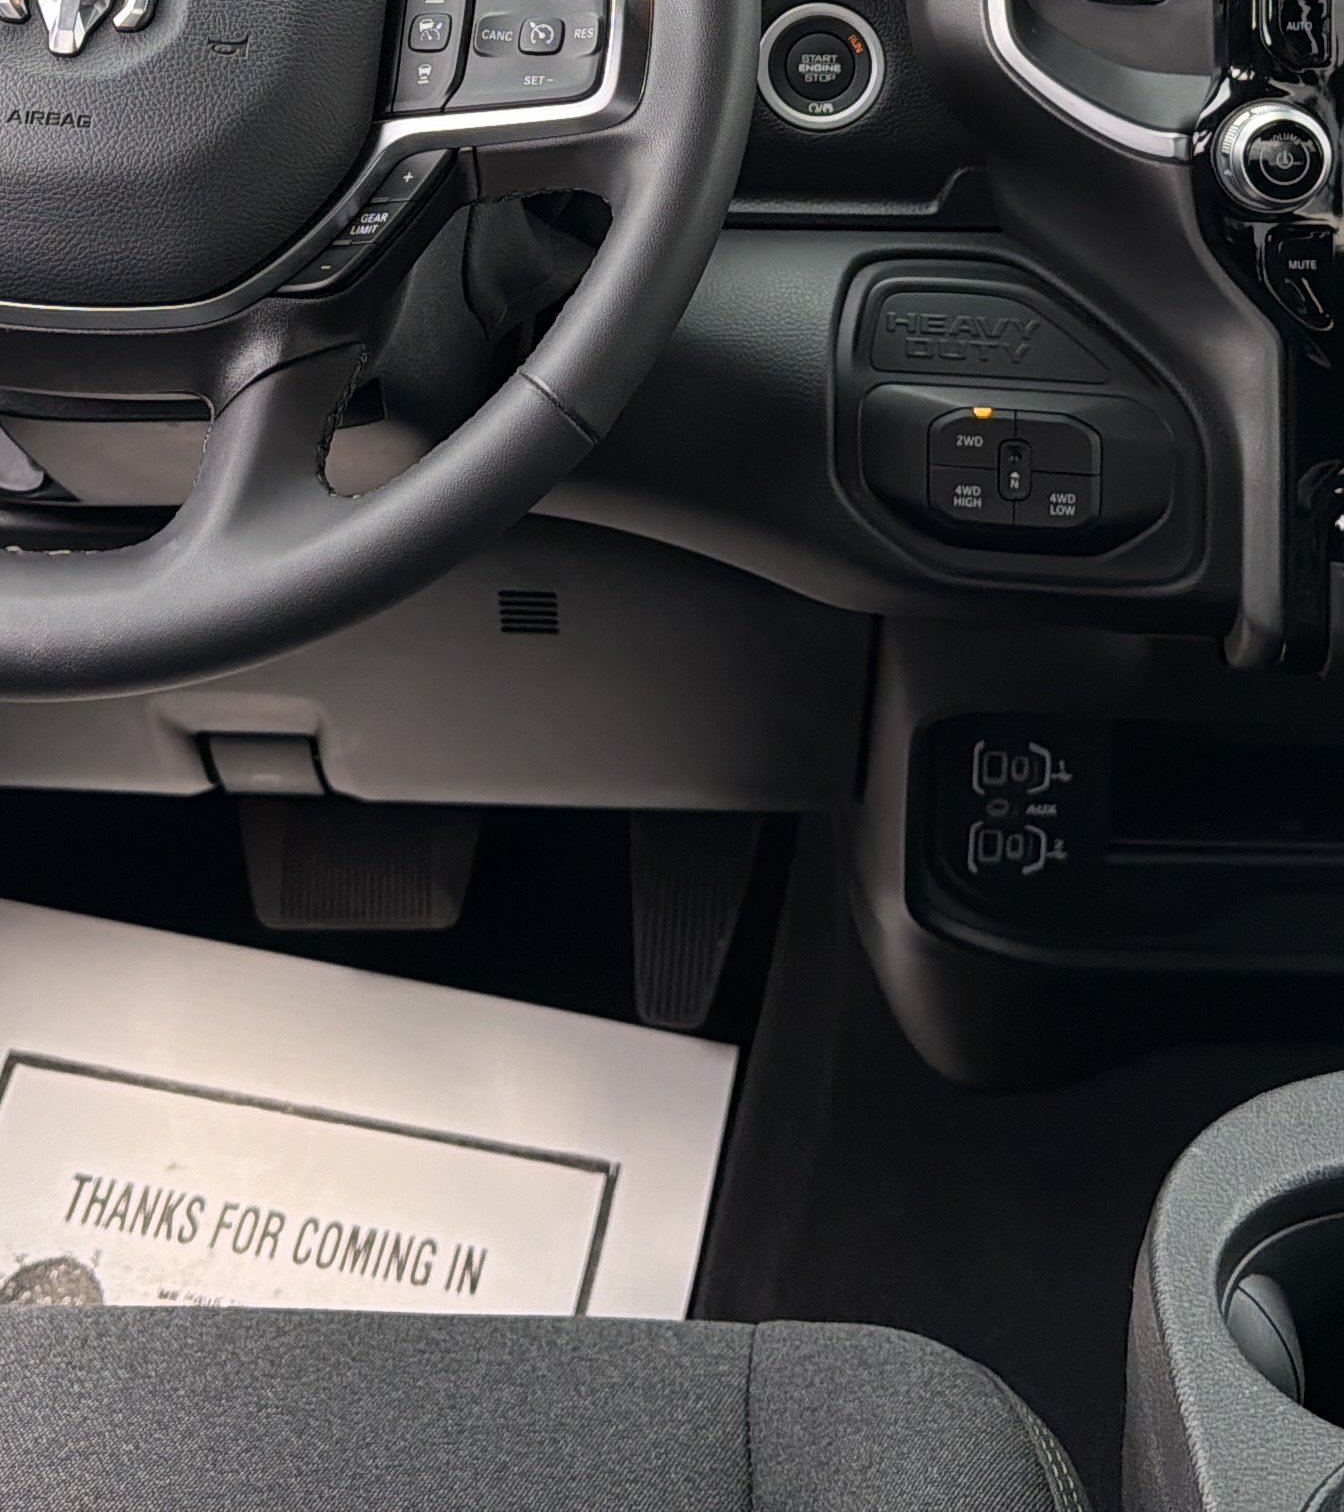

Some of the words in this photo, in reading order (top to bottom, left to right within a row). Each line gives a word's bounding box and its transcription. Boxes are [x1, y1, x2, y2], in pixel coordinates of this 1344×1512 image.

[1286, 20, 1313, 31] AUTO
[481, 28, 513, 41] CANC
[573, 28, 594, 39] RES
[801, 54, 838, 64] START
[798, 64, 842, 73] ENGINE
[804, 73, 836, 83] STOP
[5, 109, 92, 128] AIRBAG
[360, 212, 389, 224] GEAR
[349, 224, 379, 236] LIMIT
[1288, 259, 1318, 270] MUTE
[886, 311, 1041, 339] HEAVY
[906, 337, 1032, 364] DUTY
[956, 434, 984, 448] 2WD
[1009, 479, 1020, 490] N
[954, 485, 982, 497] 4WD
[953, 496, 983, 509] HIGH
[1049, 493, 1077, 505] 4WD
[1049, 504, 1076, 516] LOW
[1025, 803, 1057, 815] AUX
[64, 1172, 205, 1244] THANKS
[208, 1201, 286, 1261] FOR
[292, 1216, 439, 1287] COMING
[444, 1244, 489, 1296] IN
